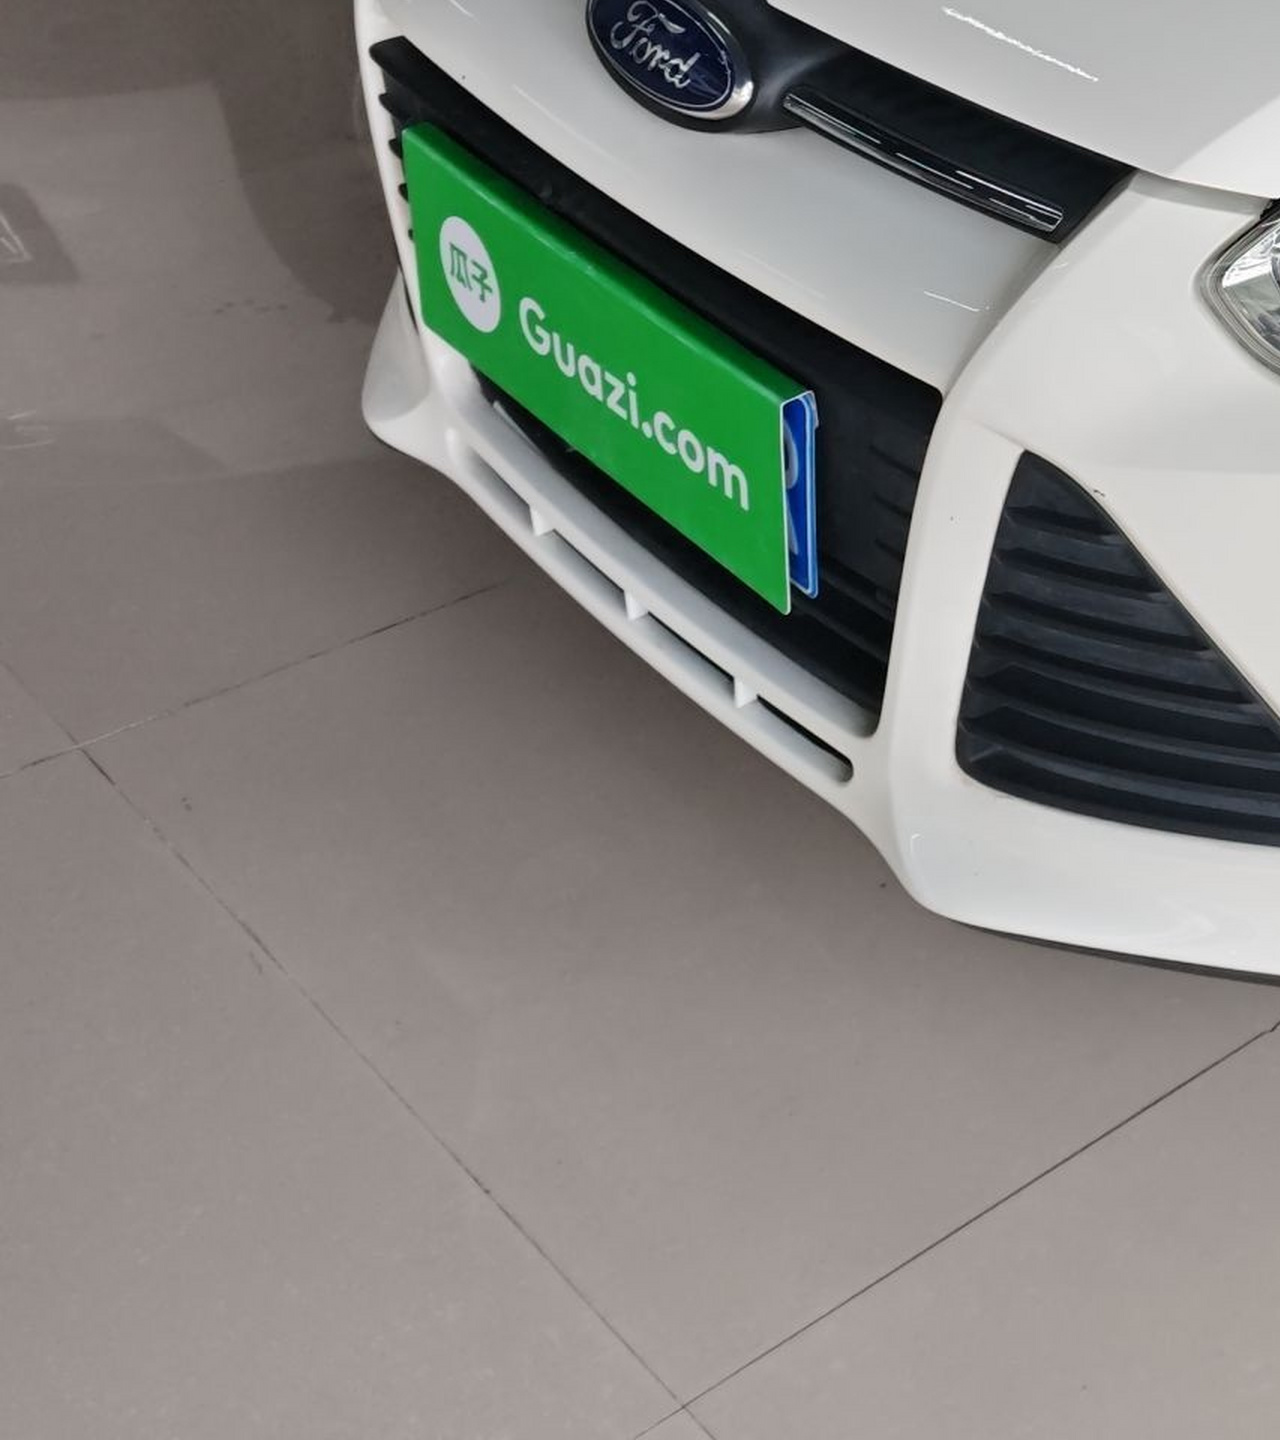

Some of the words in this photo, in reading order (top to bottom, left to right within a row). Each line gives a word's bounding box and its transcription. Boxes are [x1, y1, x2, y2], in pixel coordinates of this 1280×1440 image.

[609, 0, 701, 90] Ford
[448, 241, 493, 304] 瓜子
[518, 296, 749, 512] Guazi.com
